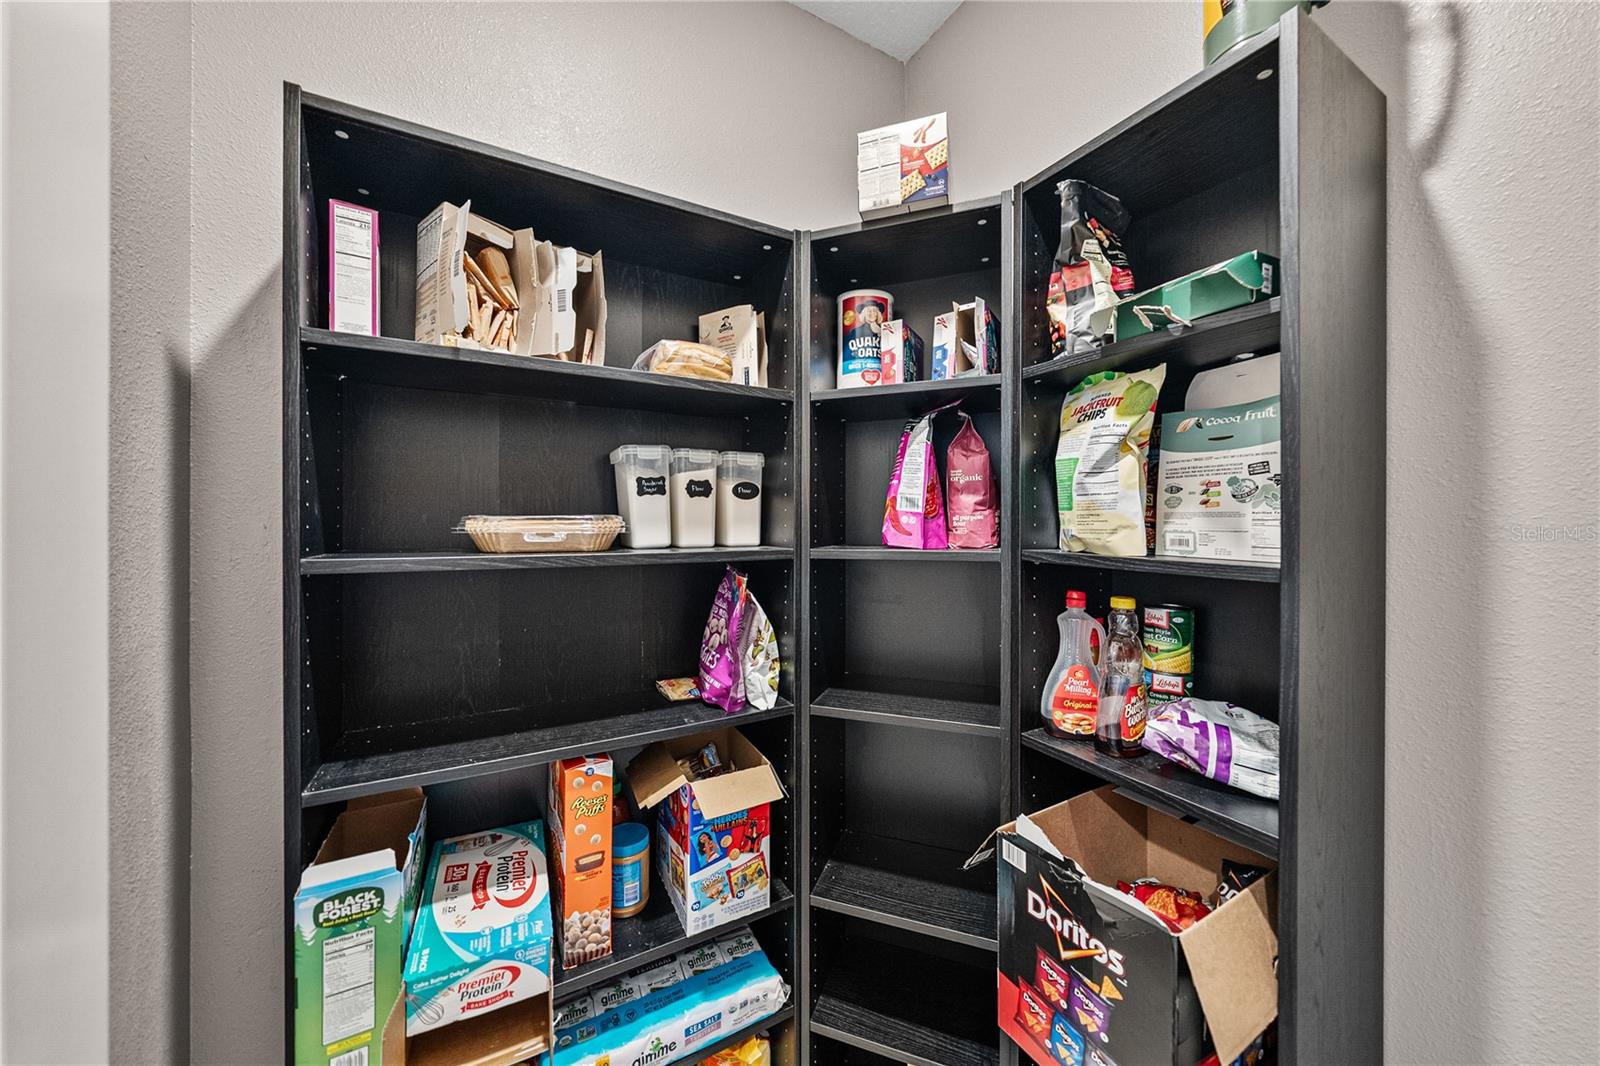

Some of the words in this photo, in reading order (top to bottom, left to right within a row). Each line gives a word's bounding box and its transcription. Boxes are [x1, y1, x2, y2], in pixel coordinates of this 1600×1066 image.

[848, 337, 881, 351] QUAK
[1071, 397, 1125, 417] JACKFRUIT
[1077, 408, 1108, 423] CHIPS
[1205, 415, 1241, 427] Cocoa
[1244, 407, 1277, 422] Fruit
[950, 473, 983, 485] organic
[1155, 633, 1178, 645] Corn
[1063, 684, 1092, 696] Milling
[1068, 677, 1090, 687] Pearl
[1156, 678, 1180, 689] Libby's
[1063, 700, 1092, 710] Original
[575, 804, 605, 820] Puffs
[496, 855, 513, 891] Protein
[512, 850, 531, 891] Premier
[323, 890, 376, 912] BLACK
[355, 929, 374, 939] Facts
[1027, 886, 1127, 977] Doritos
[727, 938, 755, 957] gimme
[687, 950, 717, 970] gimme
[457, 970, 506, 994] Premier
[460, 981, 503, 1002] Protein
[470, 1000, 488, 1010] BAKE
[600, 985, 635, 1007] gimme
[689, 1023, 702, 1035] SEA
[703, 1014, 719, 1026] SALT
